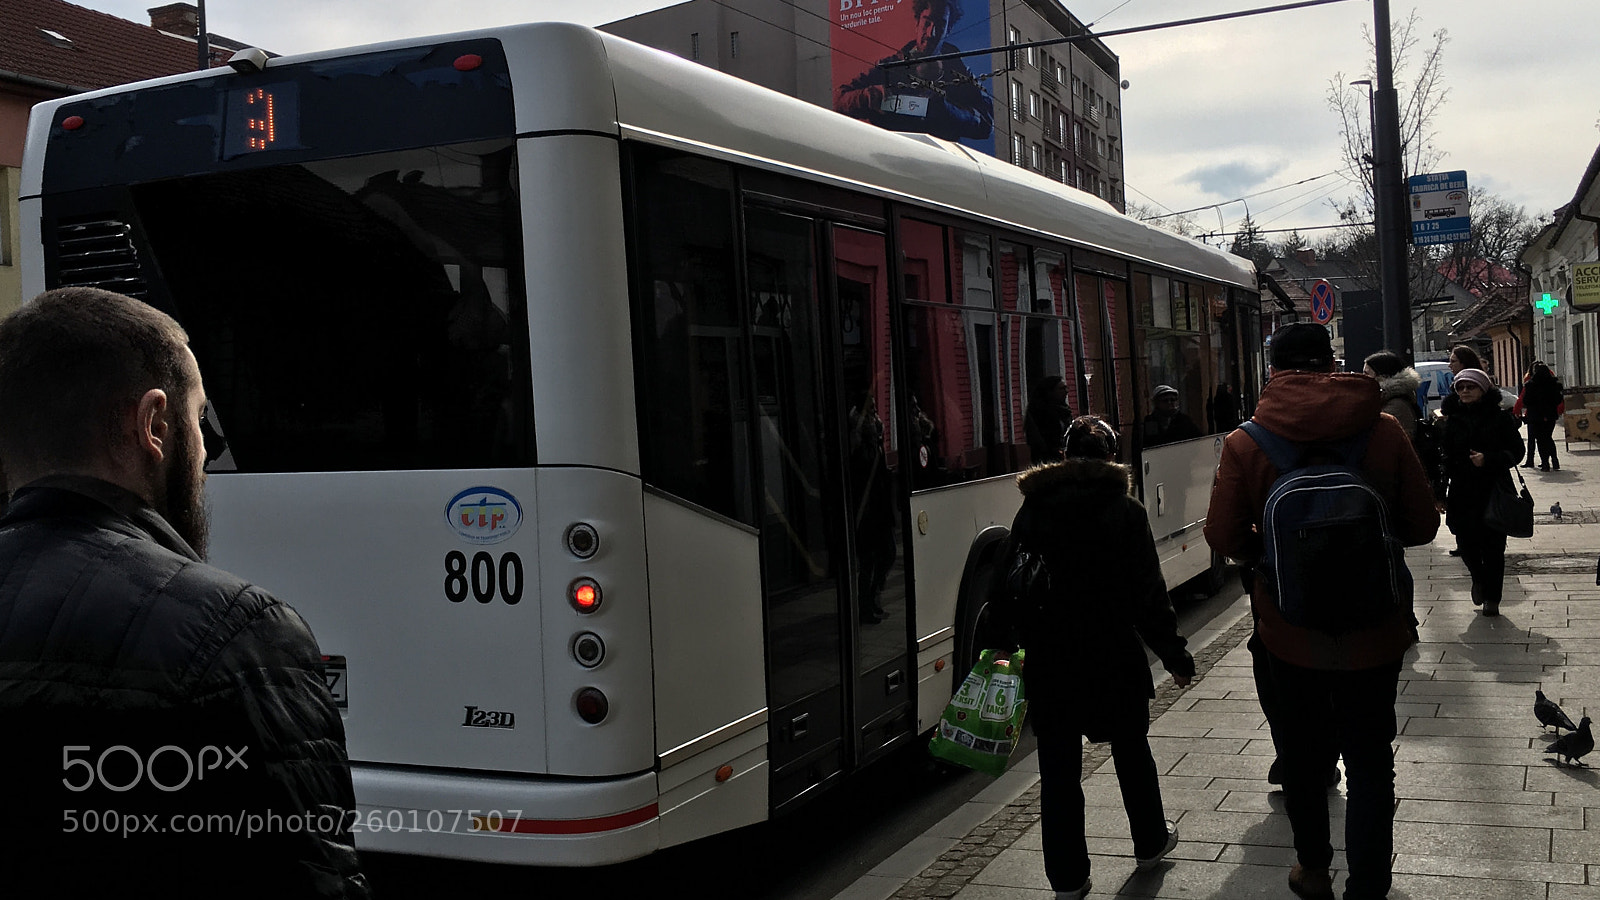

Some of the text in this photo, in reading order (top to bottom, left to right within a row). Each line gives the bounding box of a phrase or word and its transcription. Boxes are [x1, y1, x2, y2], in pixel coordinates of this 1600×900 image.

[863, 9, 872, 17] loc
[873, 4, 894, 15] pentru
[1575, 267, 1600, 276] ACC
[444, 550, 524, 605] 800
[995, 688, 1006, 706] 6
